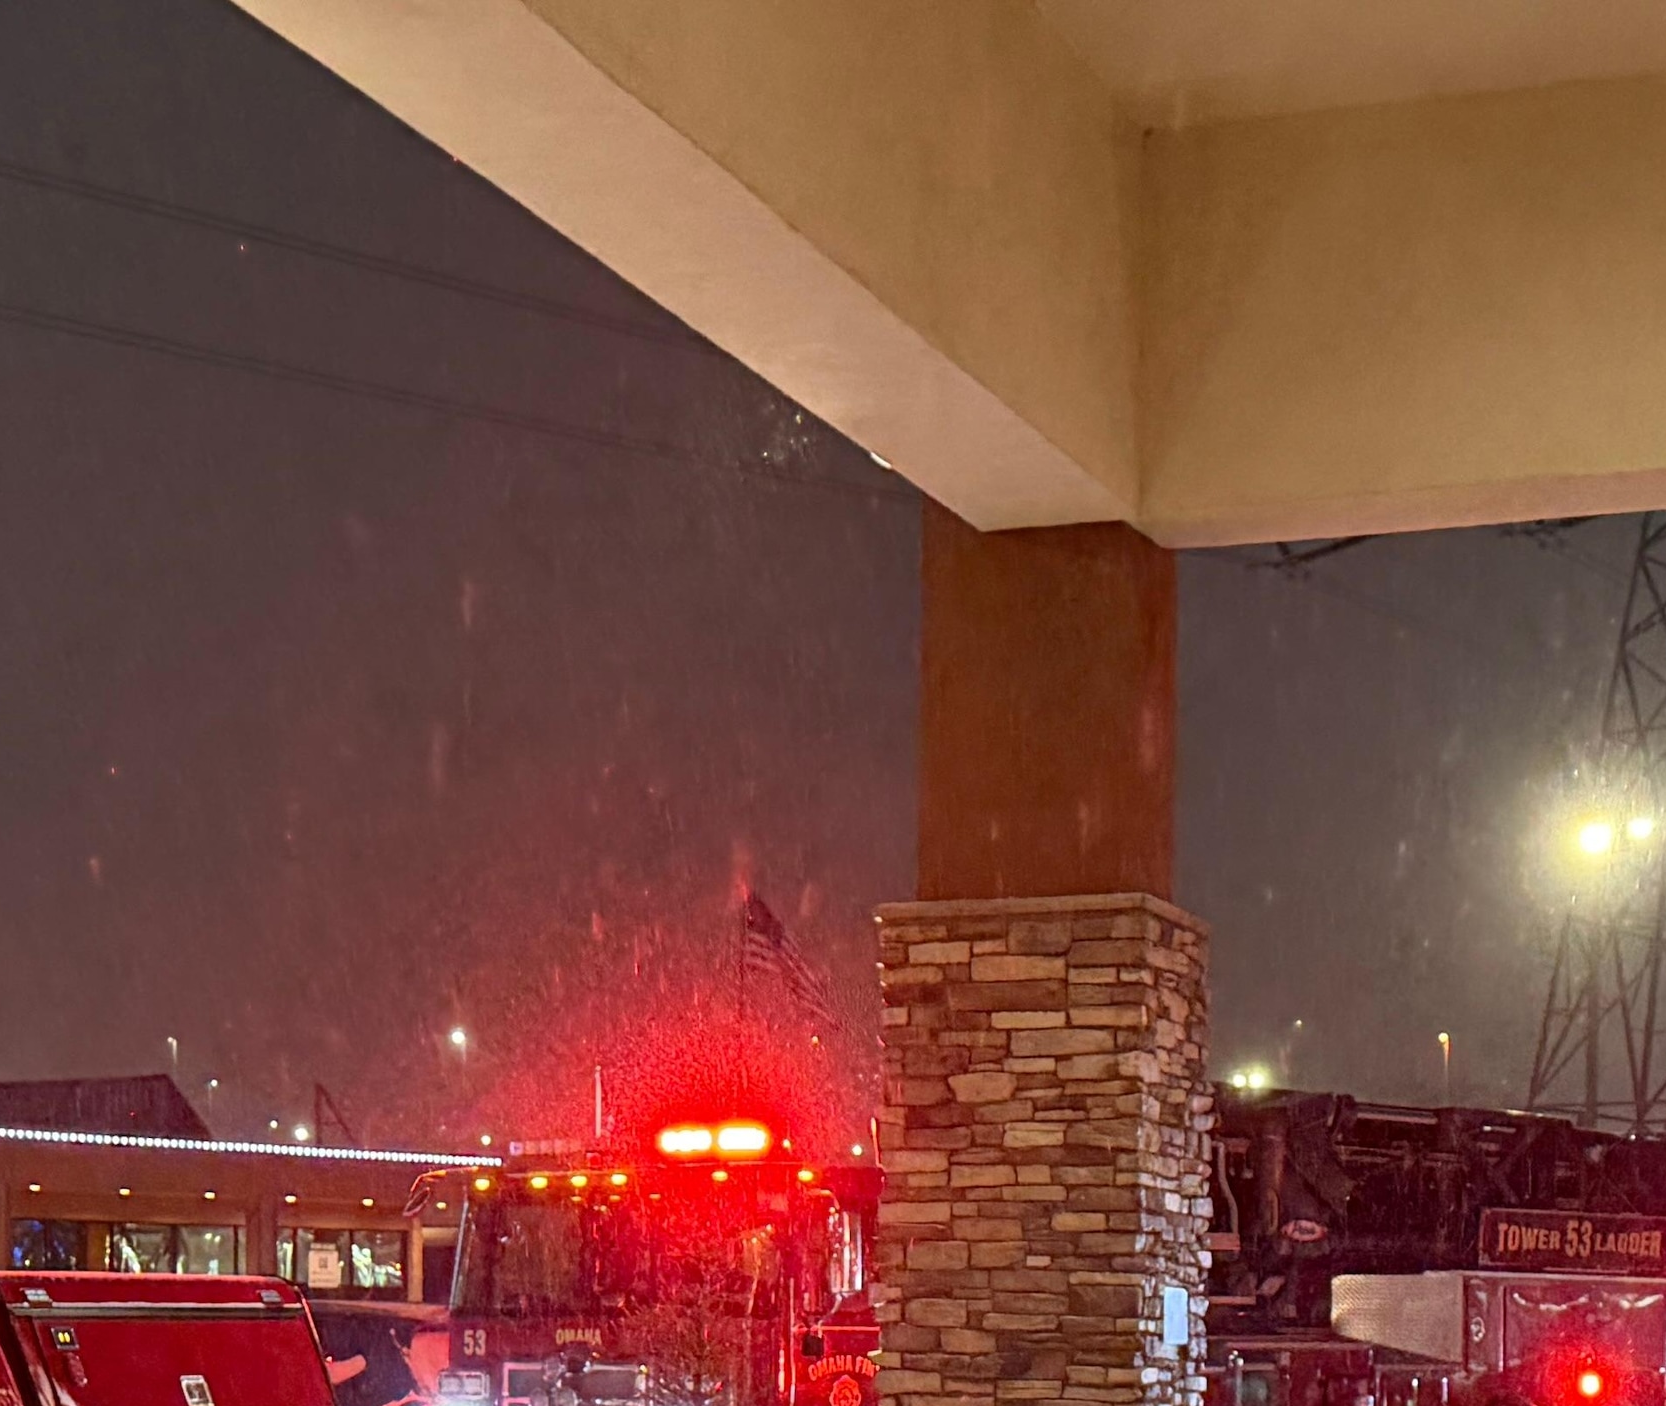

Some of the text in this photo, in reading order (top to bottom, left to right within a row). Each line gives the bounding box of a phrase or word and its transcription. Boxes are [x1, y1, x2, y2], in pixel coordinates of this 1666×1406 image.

[1498, 1219, 1662, 1258] TOWER 53 LADDER
[463, 1328, 487, 1356] 53
[555, 1327, 603, 1346] OMAHA
[808, 1354, 854, 1381] OMAHA
